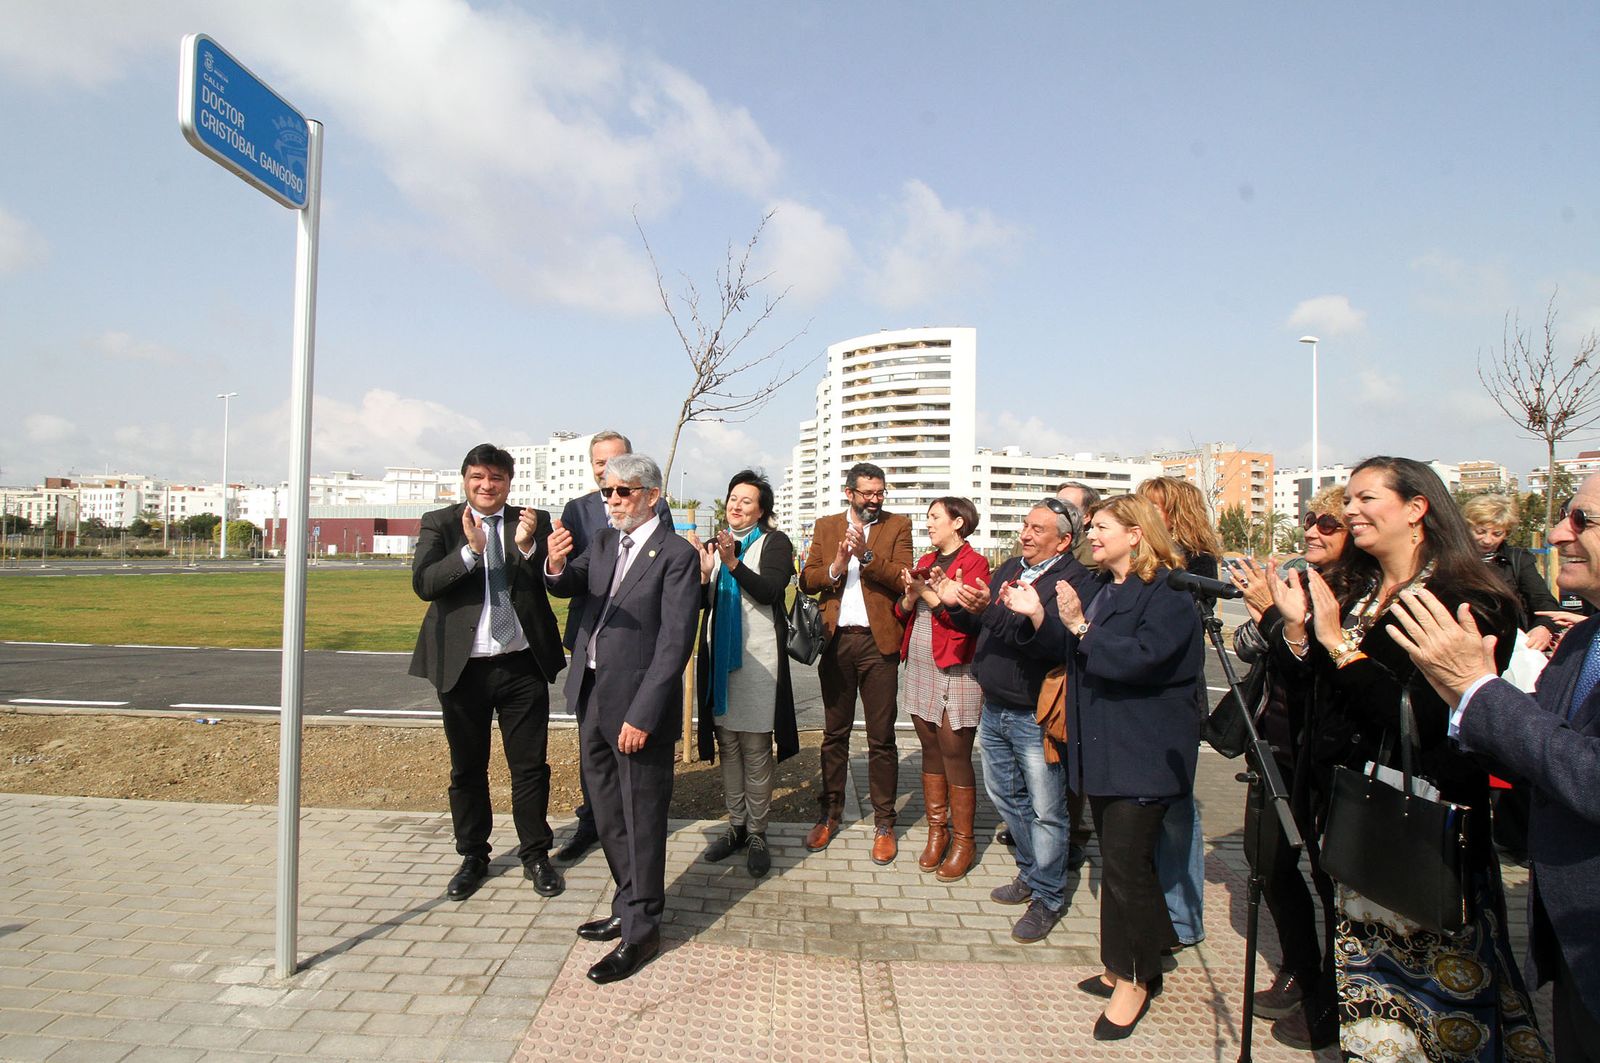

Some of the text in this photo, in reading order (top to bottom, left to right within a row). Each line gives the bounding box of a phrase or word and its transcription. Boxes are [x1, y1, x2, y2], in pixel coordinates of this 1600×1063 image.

[203, 72, 225, 94] CALLE
[201, 85, 245, 130] DOCTOR
[201, 109, 303, 193] CRISTÓBAL GANGOSO
